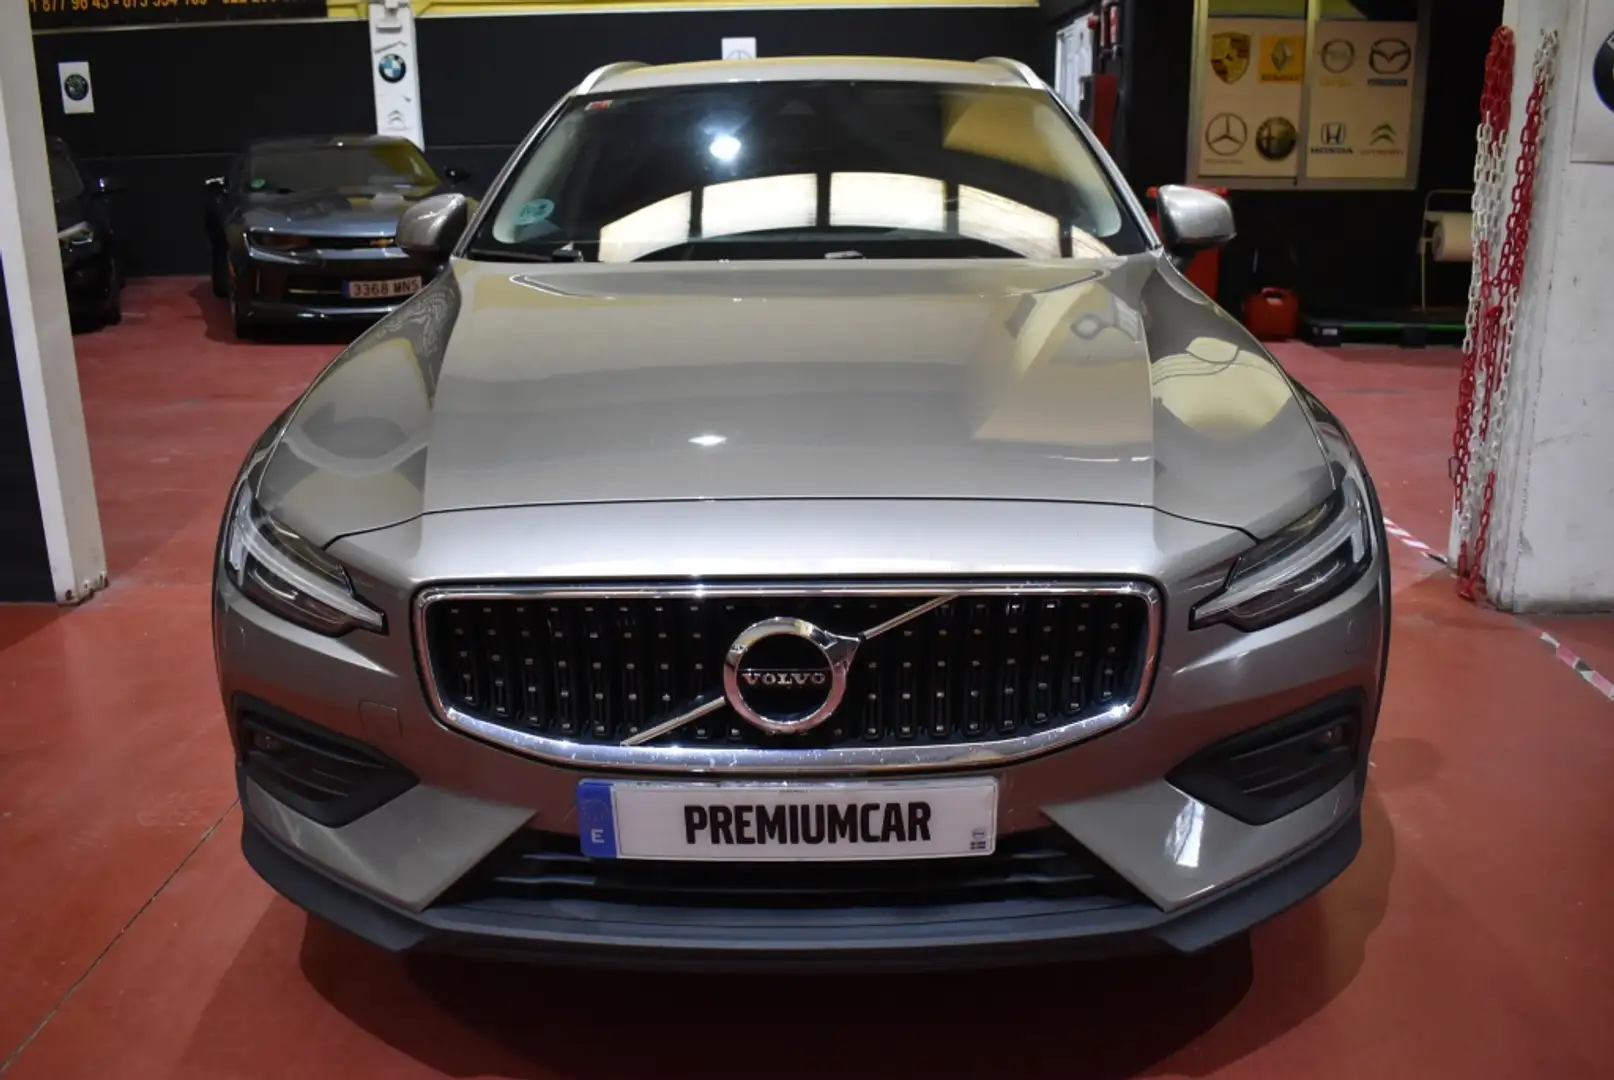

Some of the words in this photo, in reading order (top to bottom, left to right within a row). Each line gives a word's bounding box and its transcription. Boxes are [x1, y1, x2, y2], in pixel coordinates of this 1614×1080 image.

[353, 283, 389, 297] 3368
[741, 673, 826, 685] VOLVO
[684, 801, 931, 845] PREMIUMCAR
[590, 828, 605, 844] E
